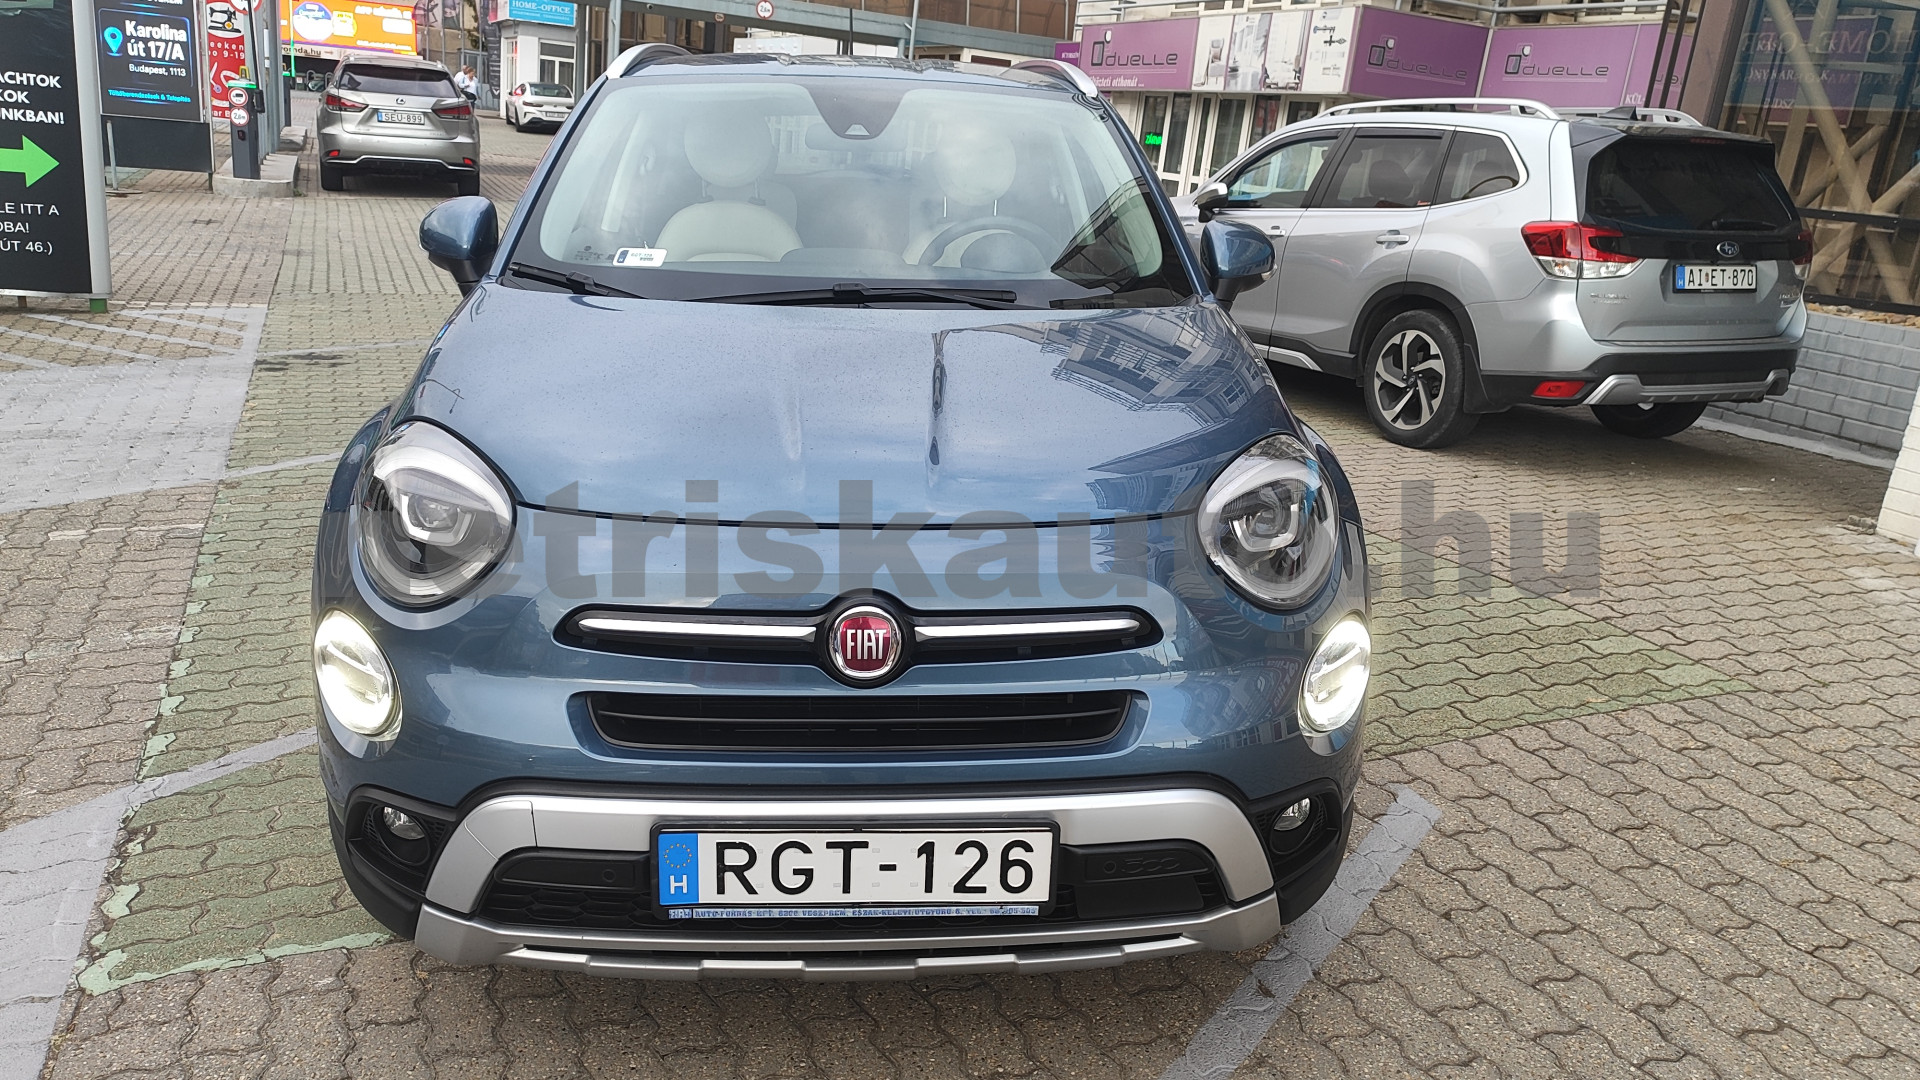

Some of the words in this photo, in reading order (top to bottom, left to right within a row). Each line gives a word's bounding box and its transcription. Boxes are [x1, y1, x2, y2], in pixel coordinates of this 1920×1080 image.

[124, 20, 188, 42] Karolina
[127, 39, 146, 57] út
[147, 41, 185, 61] 17/A
[129, 64, 168, 76] Budapest,
[170, 67, 186, 77] 1113
[0, 107, 65, 125] NKBAN!
[384, 113, 422, 123] SEU-899
[20, 203, 44, 215] ITT
[48, 204, 60, 216] A
[25, 241, 53, 256] 46.)
[846, 629, 887, 660] FIAT
[715, 839, 1035, 895] RGT-126
[669, 874, 688, 894] H
